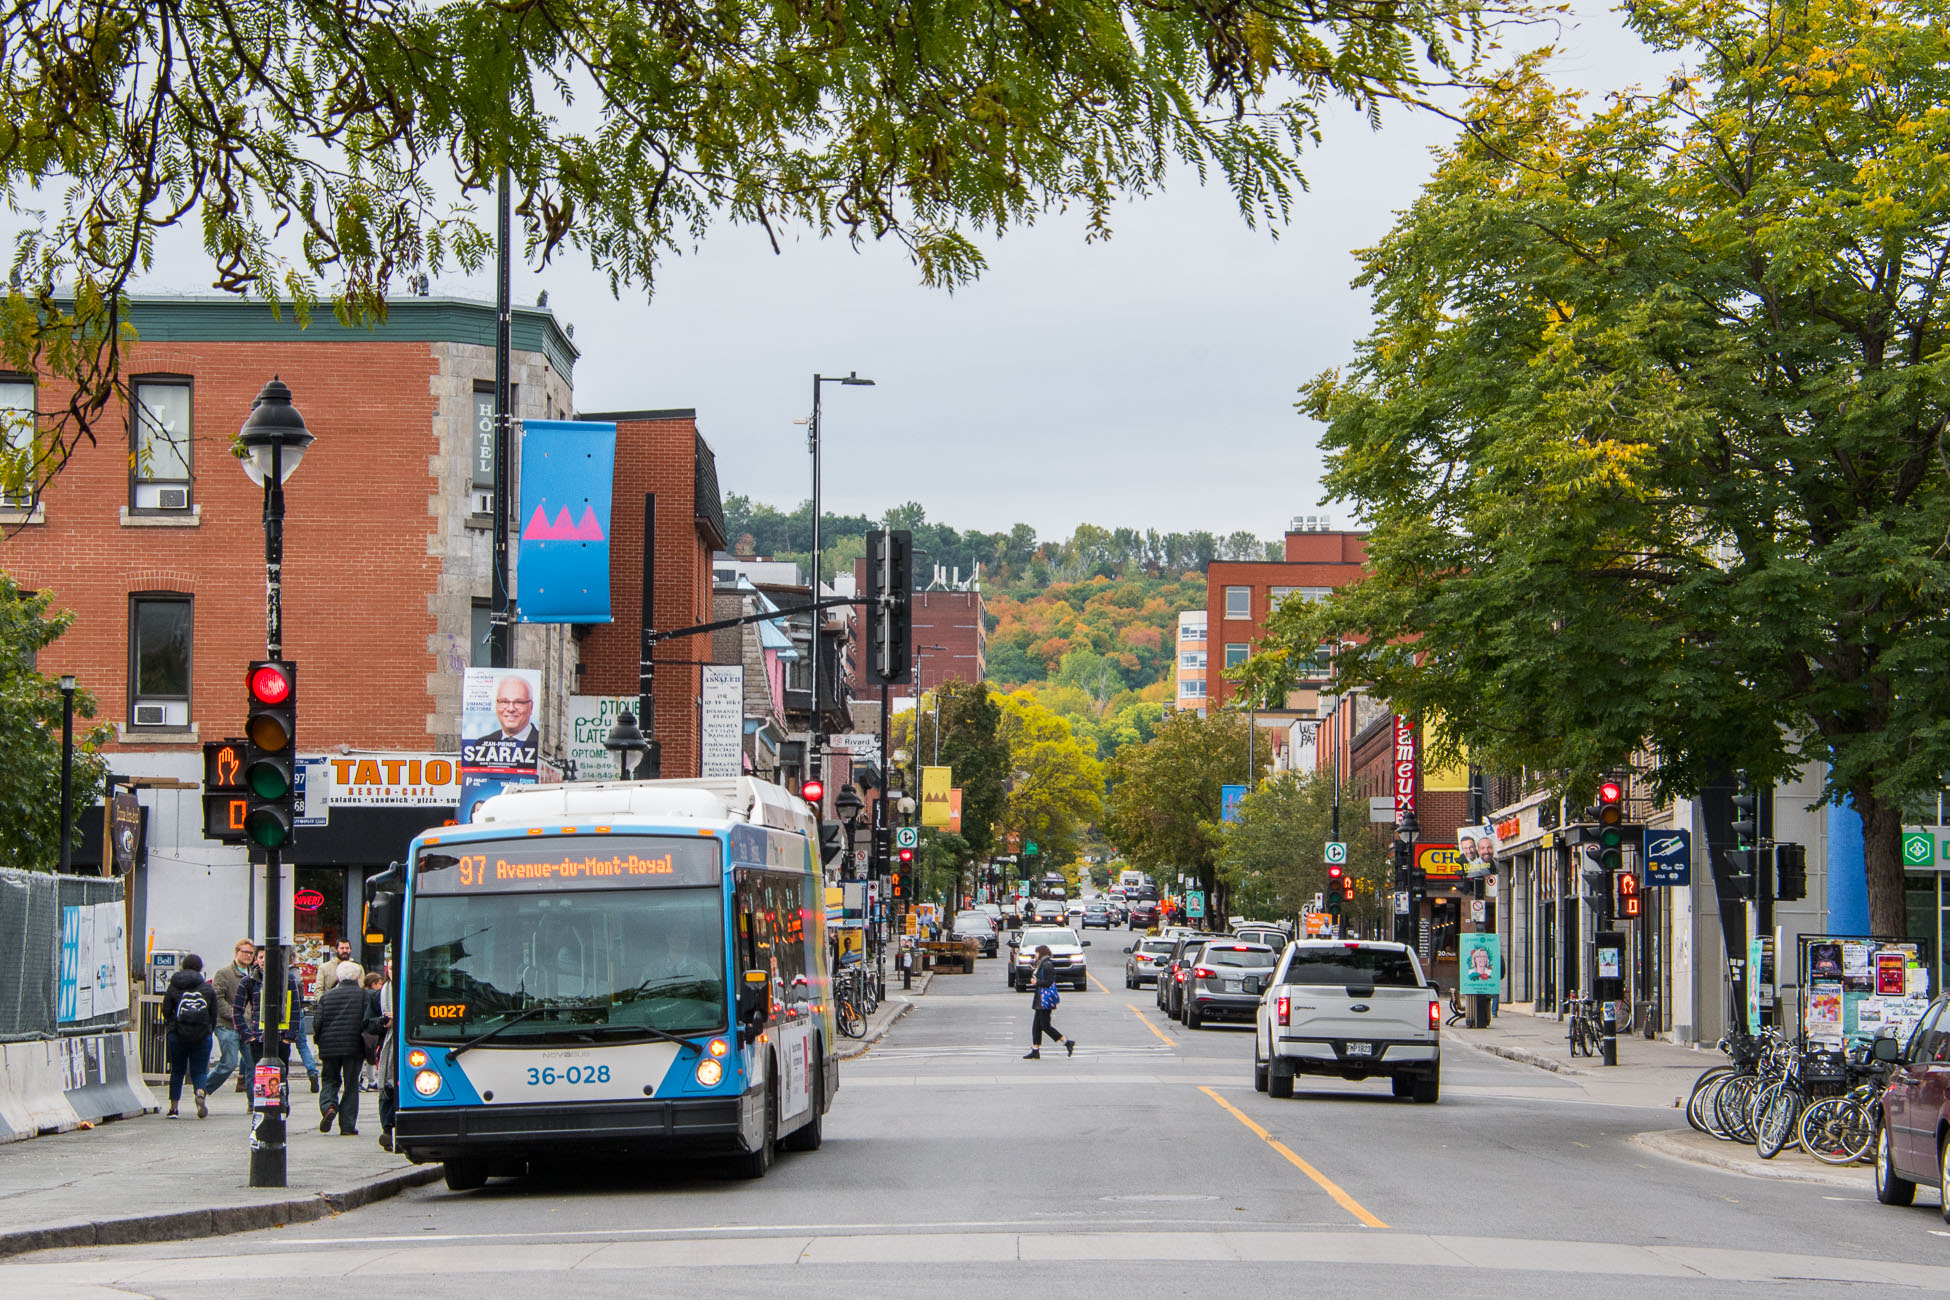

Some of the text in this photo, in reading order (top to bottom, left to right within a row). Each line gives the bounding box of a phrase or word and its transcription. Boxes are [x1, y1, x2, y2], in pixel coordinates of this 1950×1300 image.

[479, 403, 493, 472] HÔTEL
[463, 745, 536, 764] SZARAZ
[294, 773, 305, 783] 97
[294, 801, 305, 812] 68
[370, 796, 408, 804] sandwich
[459, 853, 673, 885] 97 Avenue-du-Mont-Royal
[157, 956, 172, 965] Bell
[429, 1004, 466, 1019] 0027
[527, 1065, 611, 1086] 36-028
